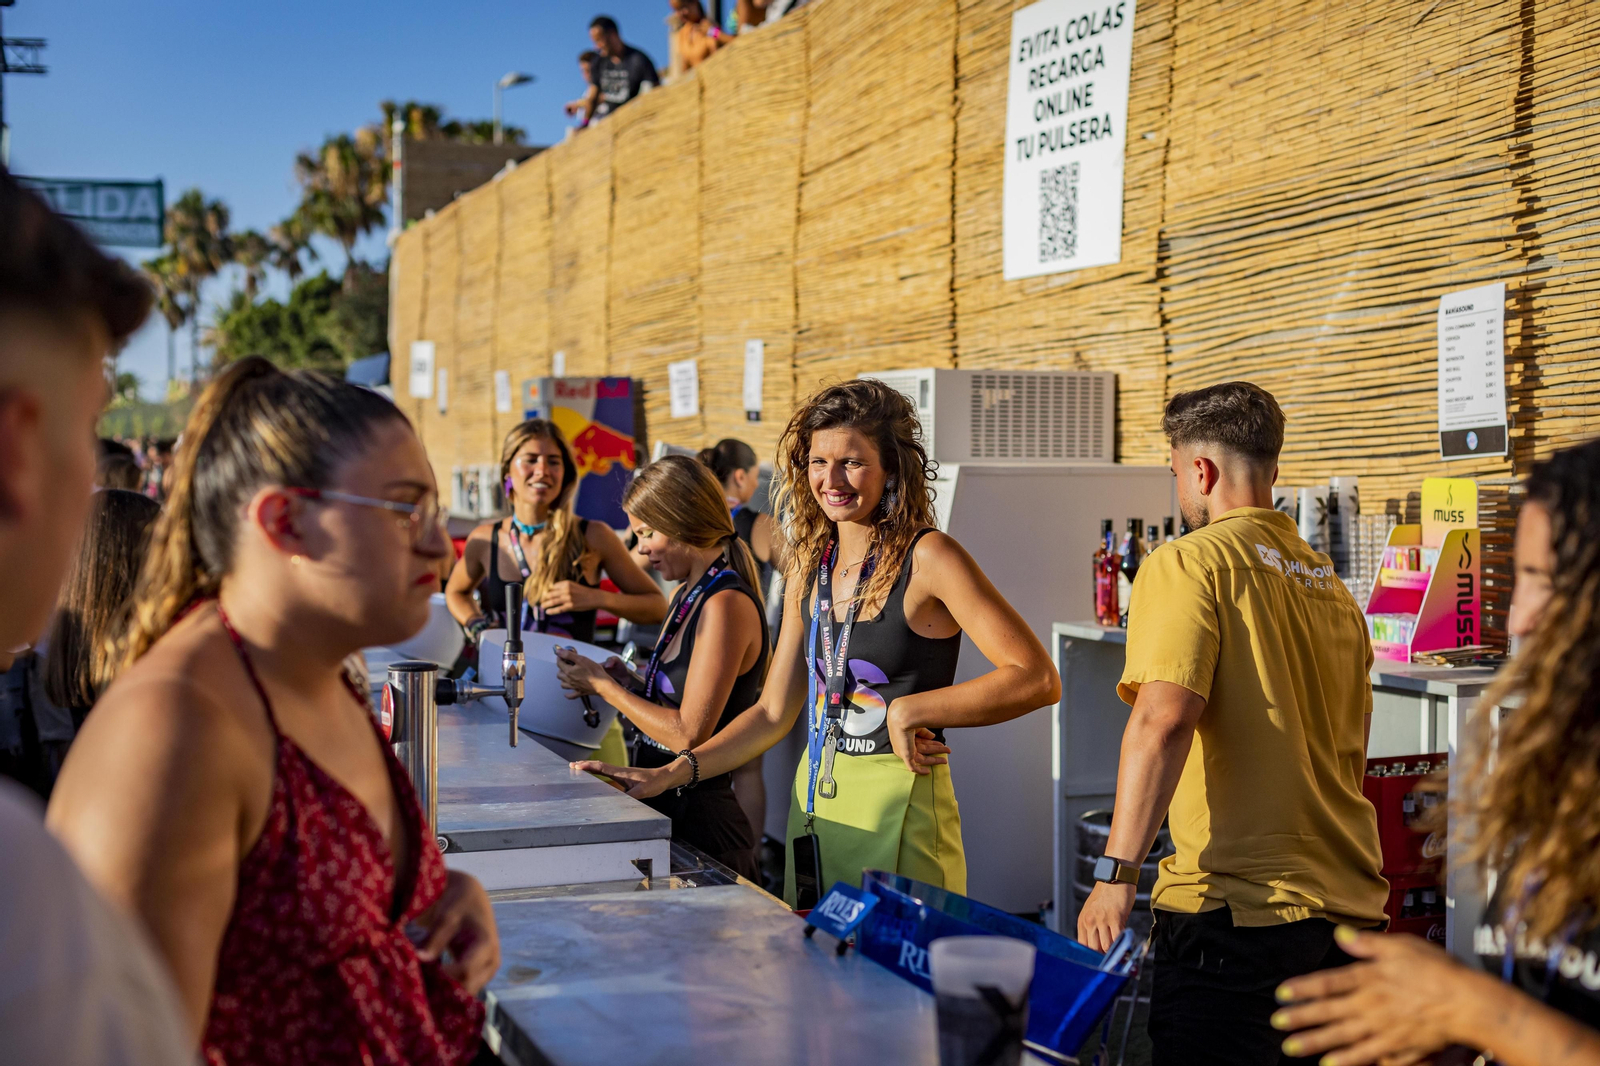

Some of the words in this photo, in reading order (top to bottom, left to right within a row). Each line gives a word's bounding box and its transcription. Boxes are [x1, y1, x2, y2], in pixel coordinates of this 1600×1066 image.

[1018, 25, 1059, 63] EVITA
[1065, 2, 1126, 44] COLAS
[1028, 45, 1105, 92] RECARGA
[1034, 82, 1094, 122] ONLINE
[1016, 134, 1035, 162] TU
[1038, 113, 1113, 156] PULSERA
[818, 890, 866, 924] RIVES
